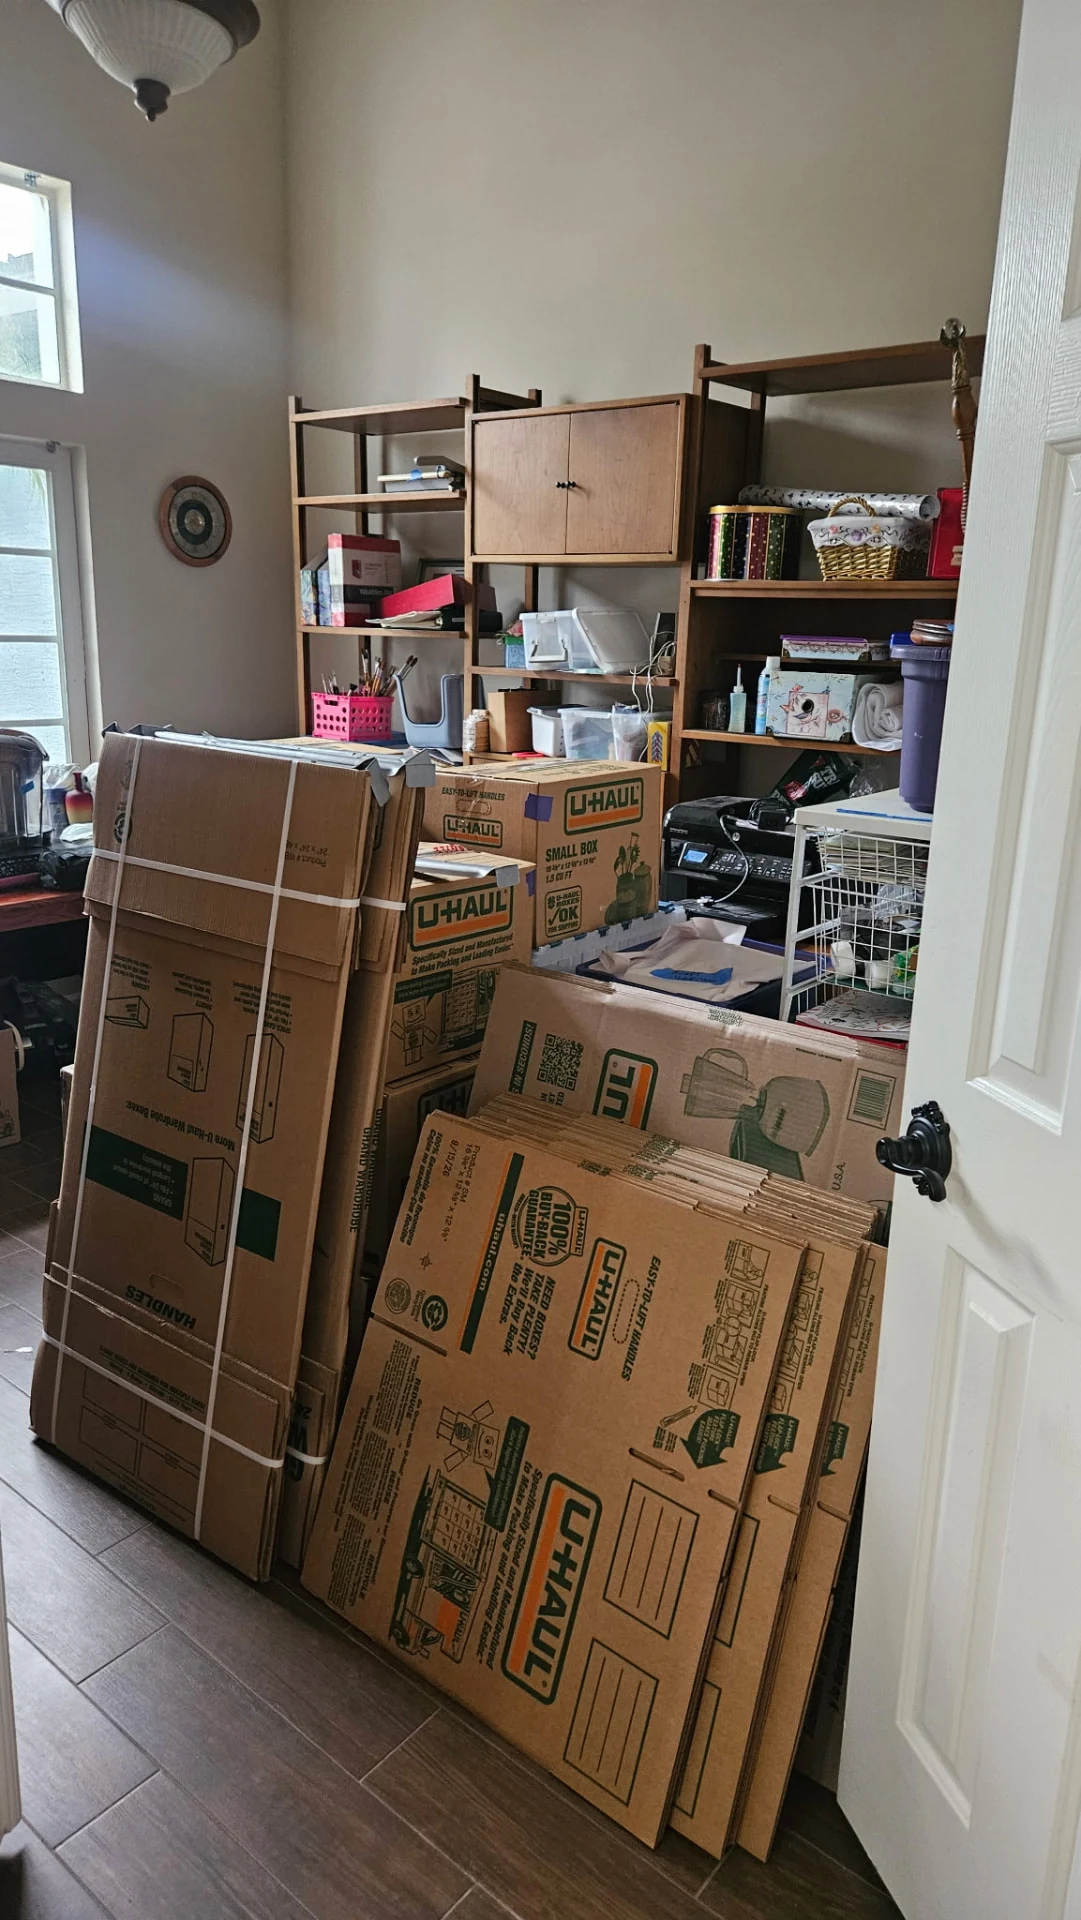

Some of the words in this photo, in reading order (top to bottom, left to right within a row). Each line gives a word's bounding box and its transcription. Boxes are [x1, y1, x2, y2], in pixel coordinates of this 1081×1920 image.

[442, 787, 478, 799] EASY-TO-LIFT
[479, 789, 505, 800] HANDLES
[570, 786, 637, 816] U-HAUL
[545, 843, 578, 862] SMALL
[580, 839, 598, 855] BOX
[563, 870, 573, 879] FT
[418, 891, 506, 929] U-HAUL
[557, 905, 579, 922] OK
[412, 951, 447, 966] Specifically
[466, 942, 476, 951] and
[476, 933, 513, 948] Manufactured
[436, 957, 460, 971] Packing
[460, 953, 472, 963] and
[149, 1109, 185, 1131] Wardrobe
[186, 1123, 213, 1143] U-Haul
[214, 1134, 235, 1151] More
[431, 1131, 443, 1154] 100%
[465, 1144, 480, 1178] Product
[831, 1161, 845, 1191] U.S.A.
[458, 1186, 468, 1203] SM
[520, 1189, 539, 1256] GUARANTEE
[530, 1191, 552, 1258] BUY-BACK
[547, 1202, 571, 1258] 100%
[574, 1207, 587, 1253] U-HAUL
[479, 1213, 504, 1290] uhaul.com
[510, 1262, 523, 1283] the
[518, 1267, 534, 1298] We'll
[529, 1272, 544, 1304] TAKE
[123, 1284, 196, 1329] HANDLES
[498, 1283, 517, 1324] Extras.
[539, 1276, 555, 1310] NEED
[580, 1249, 620, 1350] U-HAUL
[635, 1255, 661, 1329] EASY-TO-LIFT
[510, 1298, 525, 1322] Buy
[502, 1323, 518, 1355] Back
[516, 1306, 535, 1354] PLENTY!
[526, 1311, 546, 1360] BOXES?
[621, 1328, 641, 1381] HANDLES
[405, 1377, 421, 1419] REDUCE
[523, 1460, 532, 1474] to
[383, 1470, 396, 1504] REUSE
[515, 1474, 529, 1505] Make
[519, 1468, 542, 1533] Specifically
[502, 1506, 521, 1551] Packing
[497, 1552, 508, 1576] and
[511, 1534, 526, 1566] Sized
[358, 1554, 374, 1600] RECYCLE
[505, 1566, 516, 1590] and
[524, 1499, 590, 1681] U-HAUL
[484, 1575, 503, 1620] Loading
[485, 1589, 511, 1669] Manufactured
